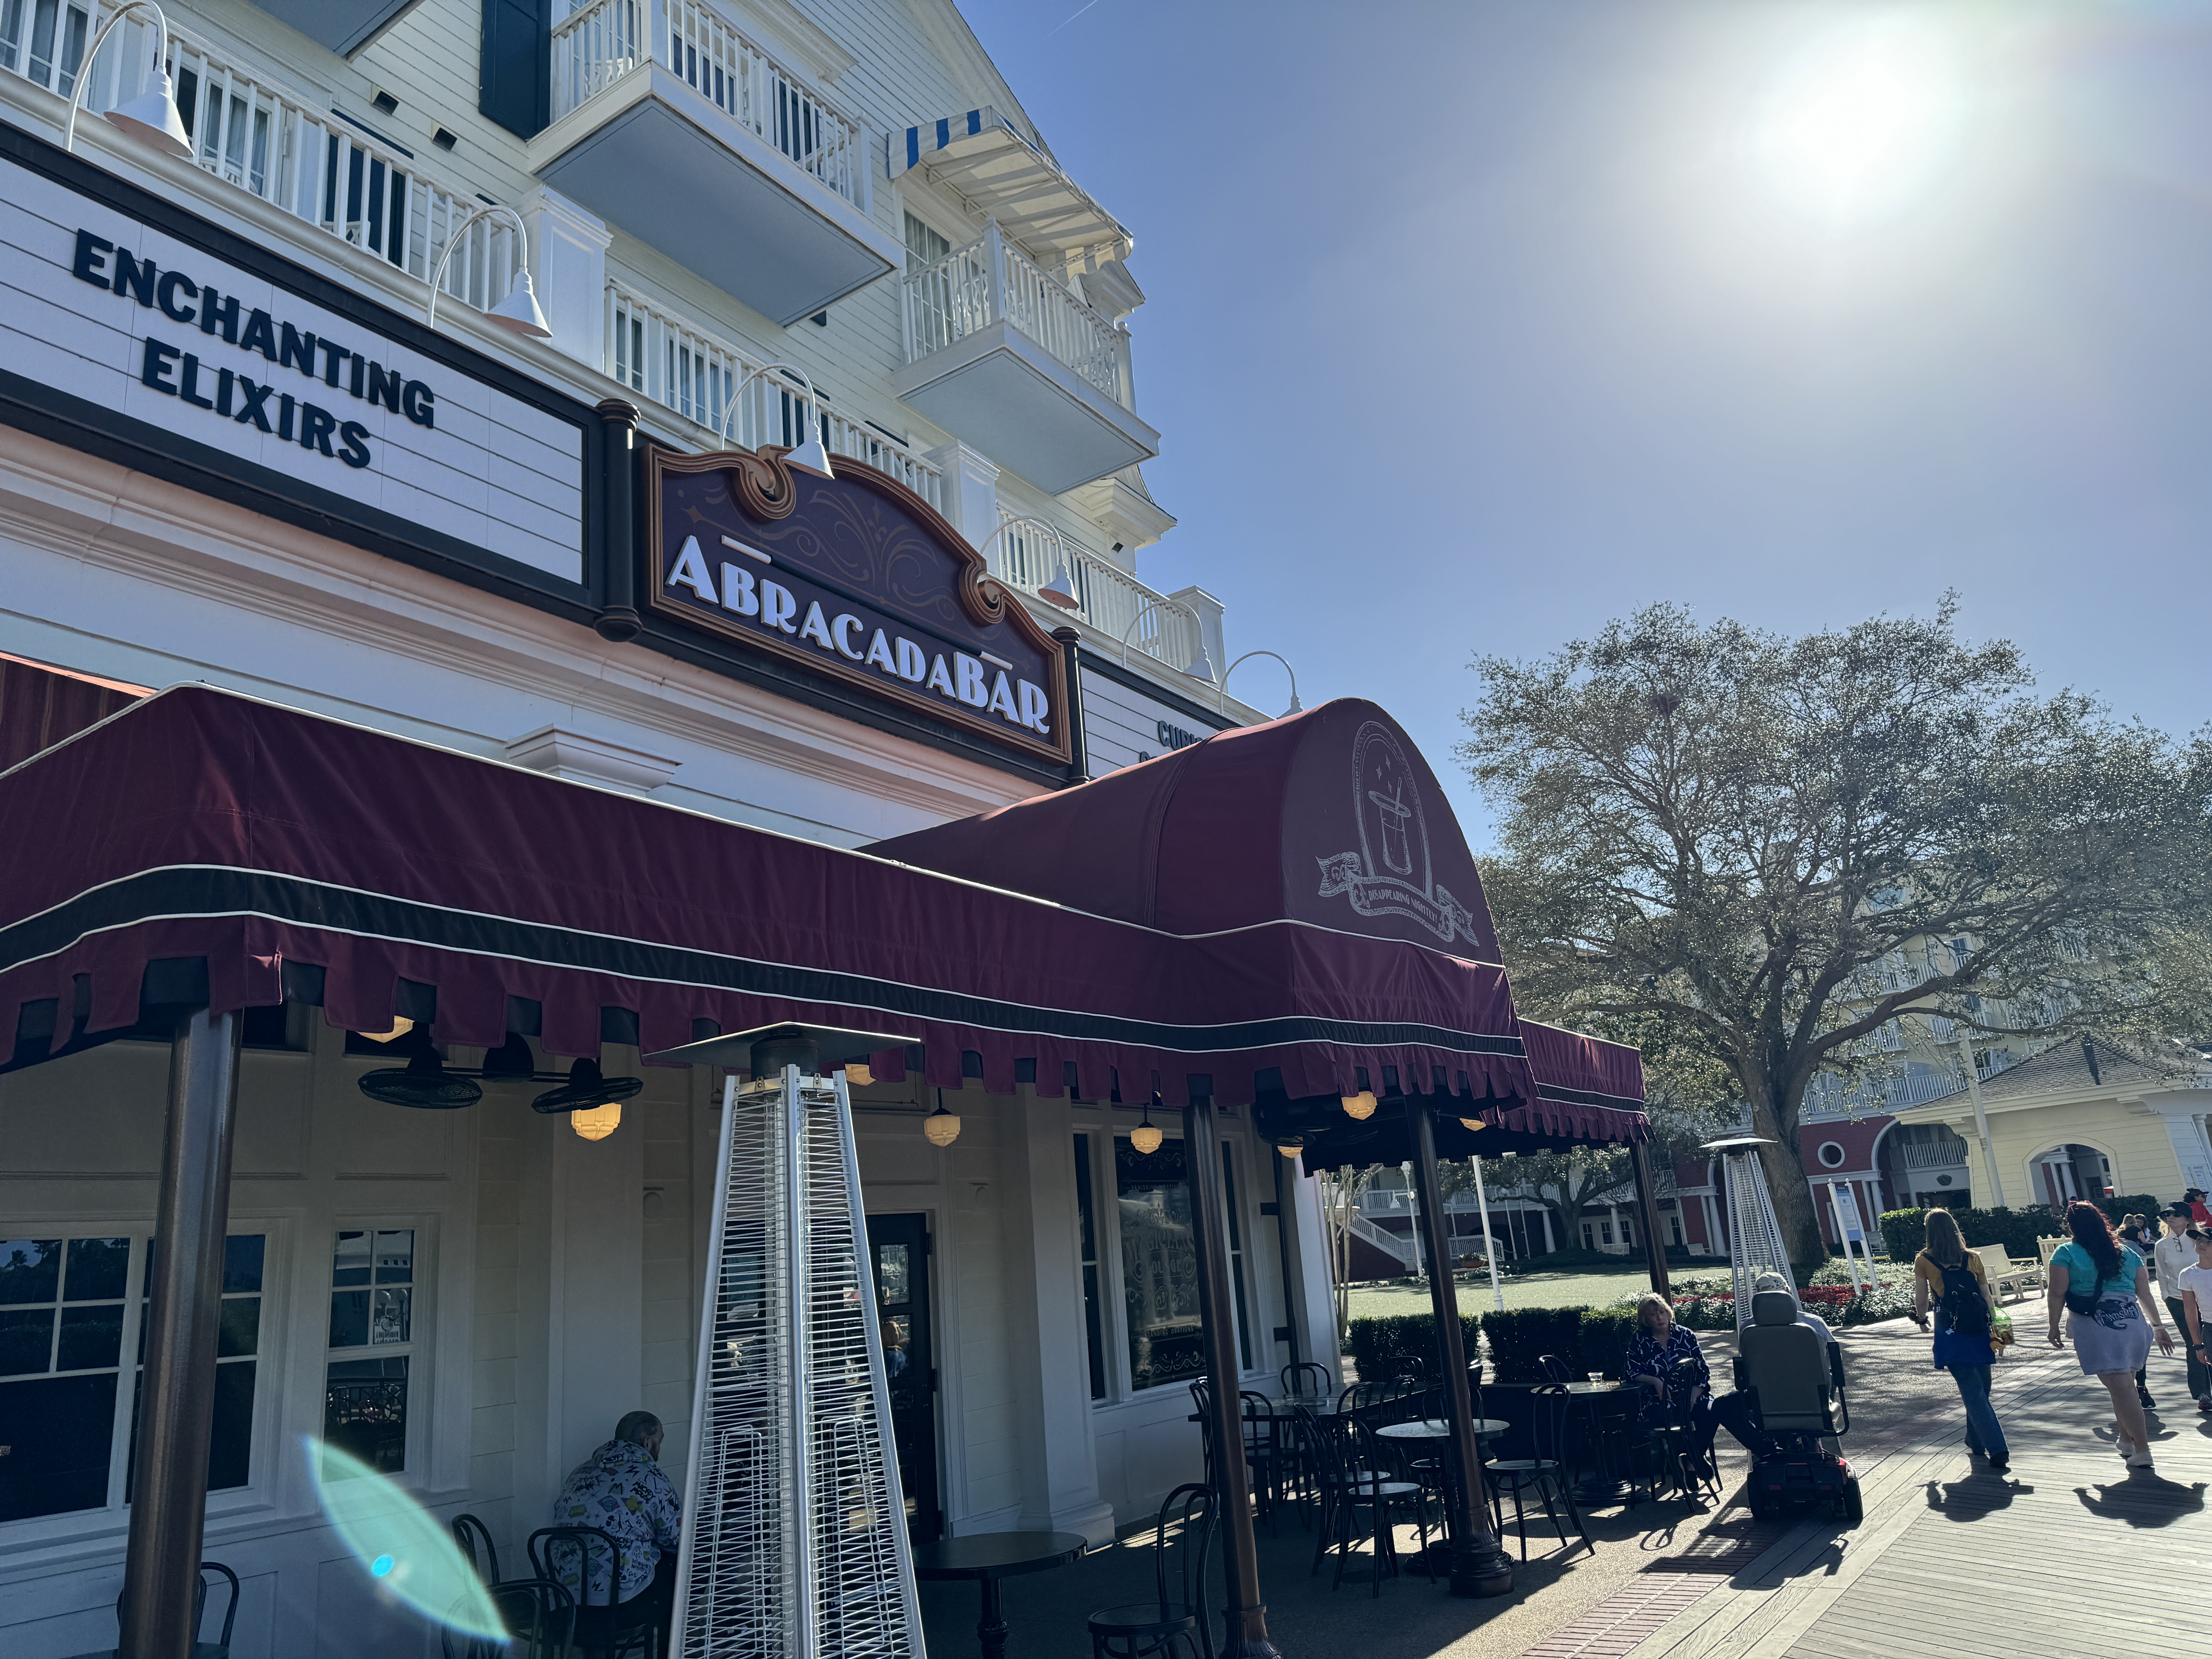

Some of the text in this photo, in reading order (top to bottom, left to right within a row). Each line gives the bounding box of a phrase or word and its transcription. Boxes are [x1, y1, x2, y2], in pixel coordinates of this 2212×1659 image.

[73, 228, 434, 429] ENCHANTING
[142, 336, 371, 468] ELIXIRS
[665, 535, 1050, 735] ABRACADABAR
[1158, 720, 1203, 751] CUR
[1368, 889, 1437, 923] DISAPPEARING NIGHTLY!
[1171, 1326, 1194, 1334] OVATIONS
